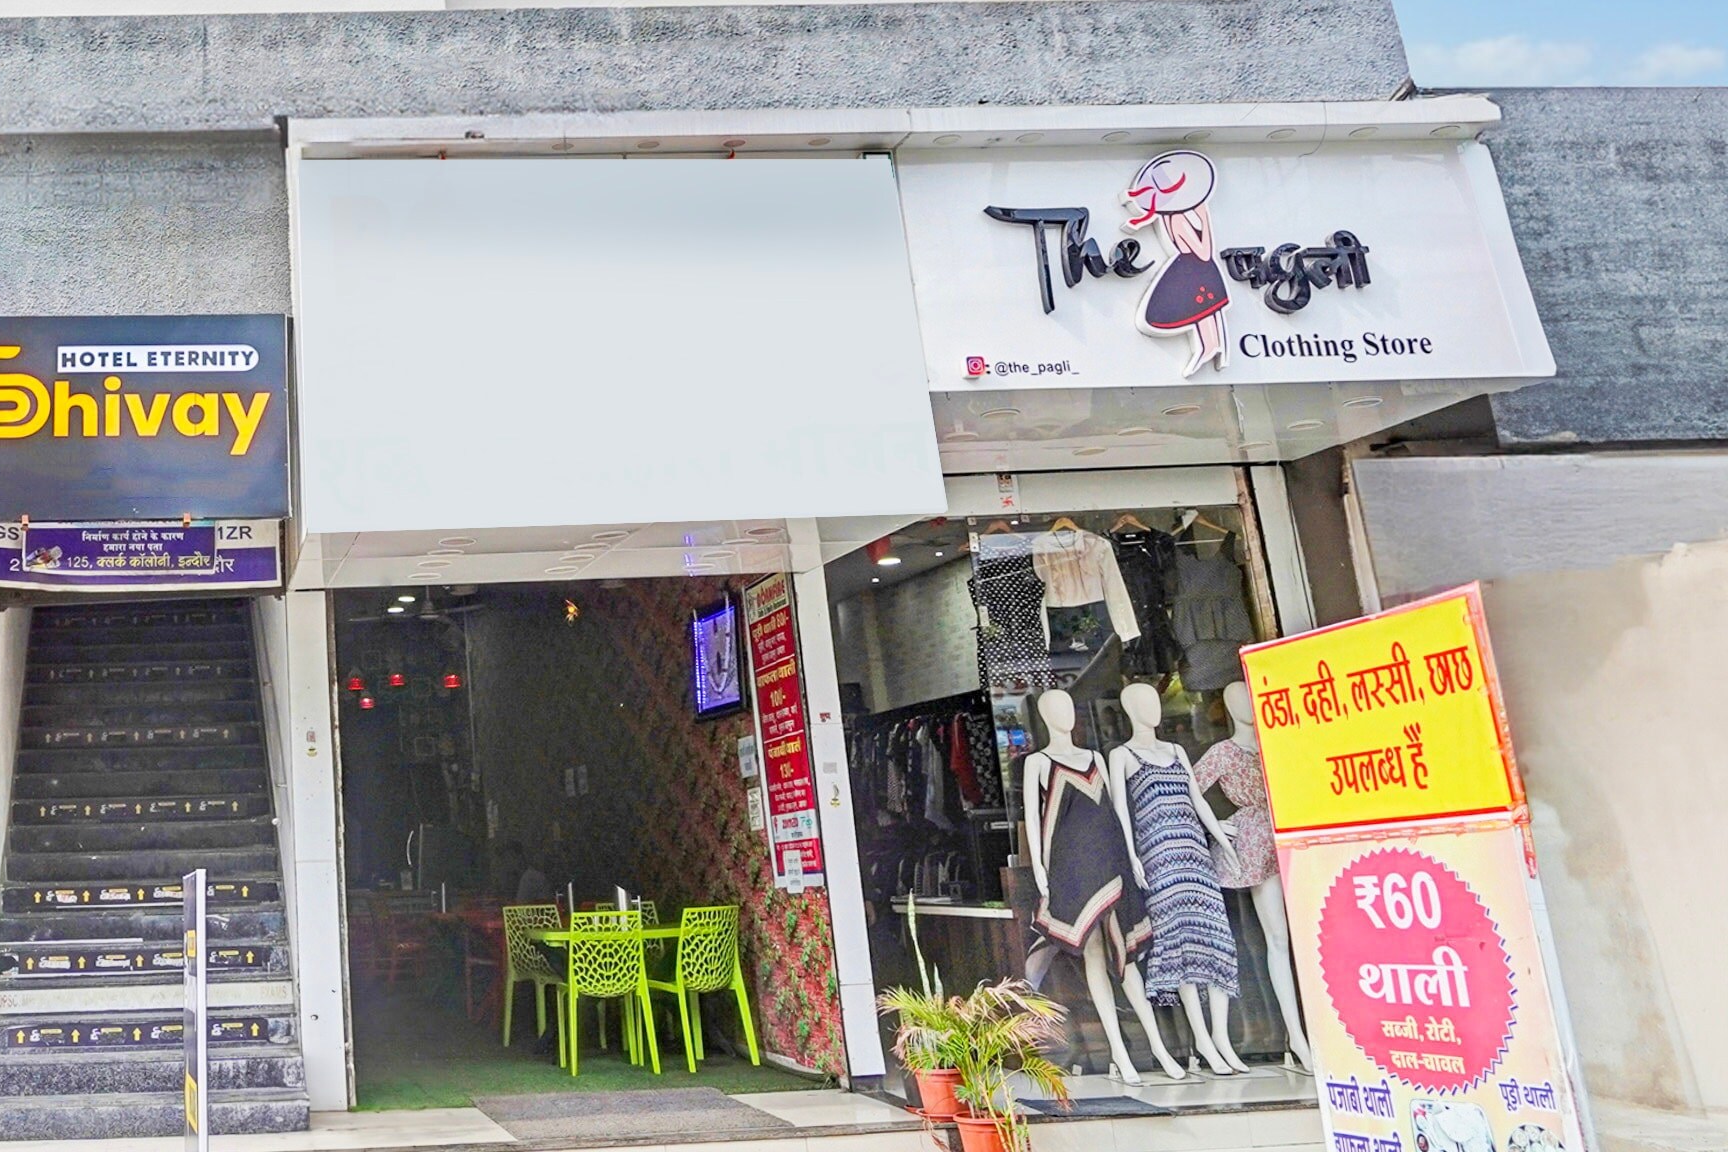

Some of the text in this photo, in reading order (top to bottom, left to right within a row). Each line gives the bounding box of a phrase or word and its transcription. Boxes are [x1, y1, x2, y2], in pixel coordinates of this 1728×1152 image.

[982, 205, 1155, 314] The
[61, 350, 254, 367] HOTEL ETERNITY
[1239, 331, 1433, 363] Clothing Store
[994, 360, 1079, 376] @the_pagli_
[149, 531, 159, 541] के
[160, 532, 184, 541] कारण
[67, 557, 93, 569] 125,
[1258, 642, 1472, 729] ठंडा, दही, लस्सी, छाछ
[1325, 722, 1429, 796] उपलब्ध हैं
[1352, 870, 1442, 929] ₹60
[1358, 945, 1471, 1008] थाली
[1326, 1074, 1395, 1118] पंजाबी थाली
[1523, 1081, 1556, 1110] थाली
